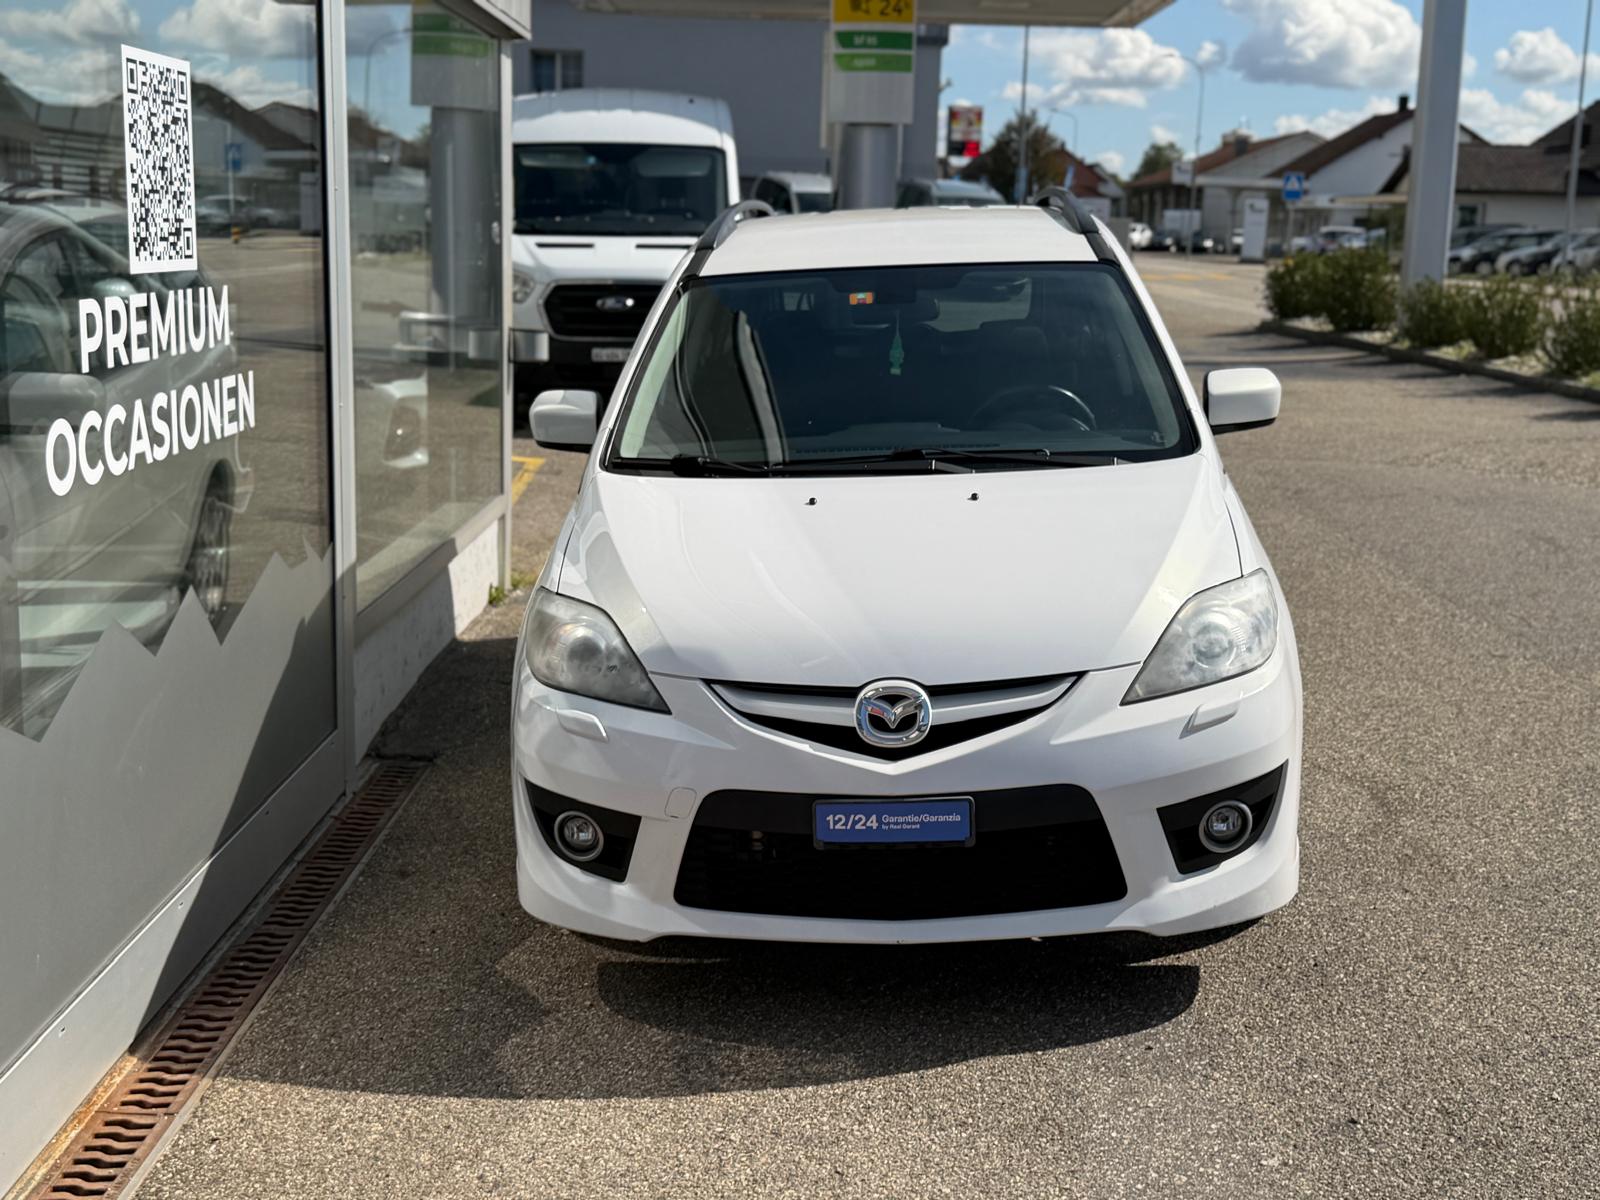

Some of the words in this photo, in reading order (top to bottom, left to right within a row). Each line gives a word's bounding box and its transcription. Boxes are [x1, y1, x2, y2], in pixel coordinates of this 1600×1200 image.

[78, 284, 231, 374] PREMIUM
[45, 370, 255, 496] OCCASIONEN
[826, 814, 879, 830] 12/24
[882, 812, 961, 823] Garantie/Garanzia
